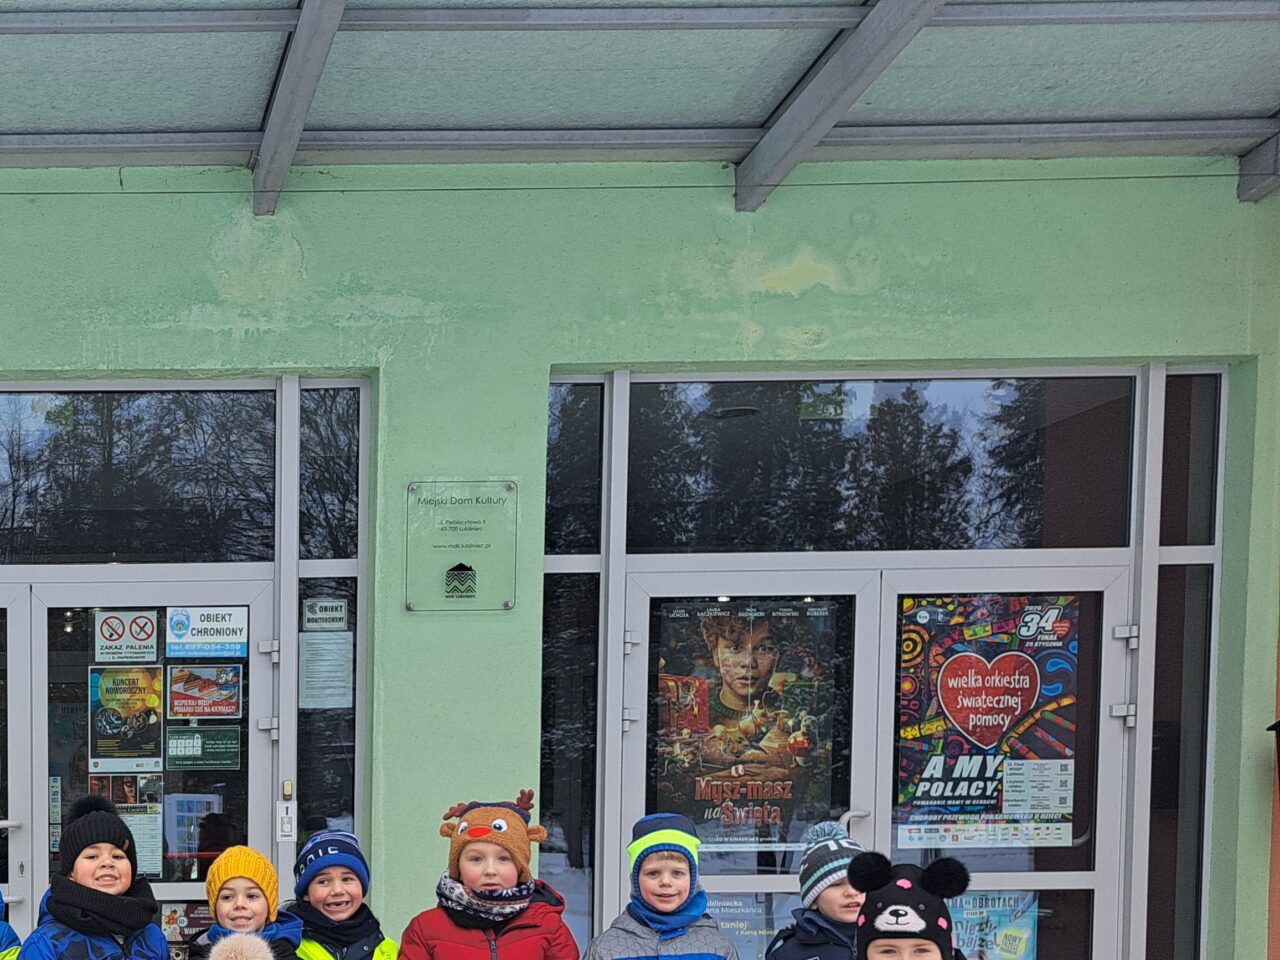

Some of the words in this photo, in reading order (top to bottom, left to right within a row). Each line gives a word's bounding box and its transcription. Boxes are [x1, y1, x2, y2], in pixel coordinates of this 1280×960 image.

[417, 497, 449, 507] Miejski
[450, 497, 473, 505] Dom
[475, 497, 507, 506] Kultury
[319, 605, 343, 613] OBIEKT
[200, 613, 233, 623] OBIEKT
[1019, 607, 1060, 638] 34
[190, 627, 244, 637] CHRONIONY
[112, 678, 140, 686] KONCERT
[219, 672, 234, 683] 34
[948, 669, 982, 688] wielka
[984, 669, 1030, 688] orkiestra
[105, 686, 147, 695] NOWOROCZNY
[956, 690, 1021, 715] świątecznej
[969, 711, 1012, 731] pomocy
[922, 755, 945, 778] A
[951, 755, 1006, 779] MY,
[694, 777, 793, 805] Mysz-masz
[915, 780, 1000, 797] POLACY,
[704, 807, 720, 820] na
[721, 800, 781, 826] Święta
[972, 896, 1019, 909] OBROTACH
[721, 920, 748, 930] taniej
[956, 932, 1000, 951] bajzel
